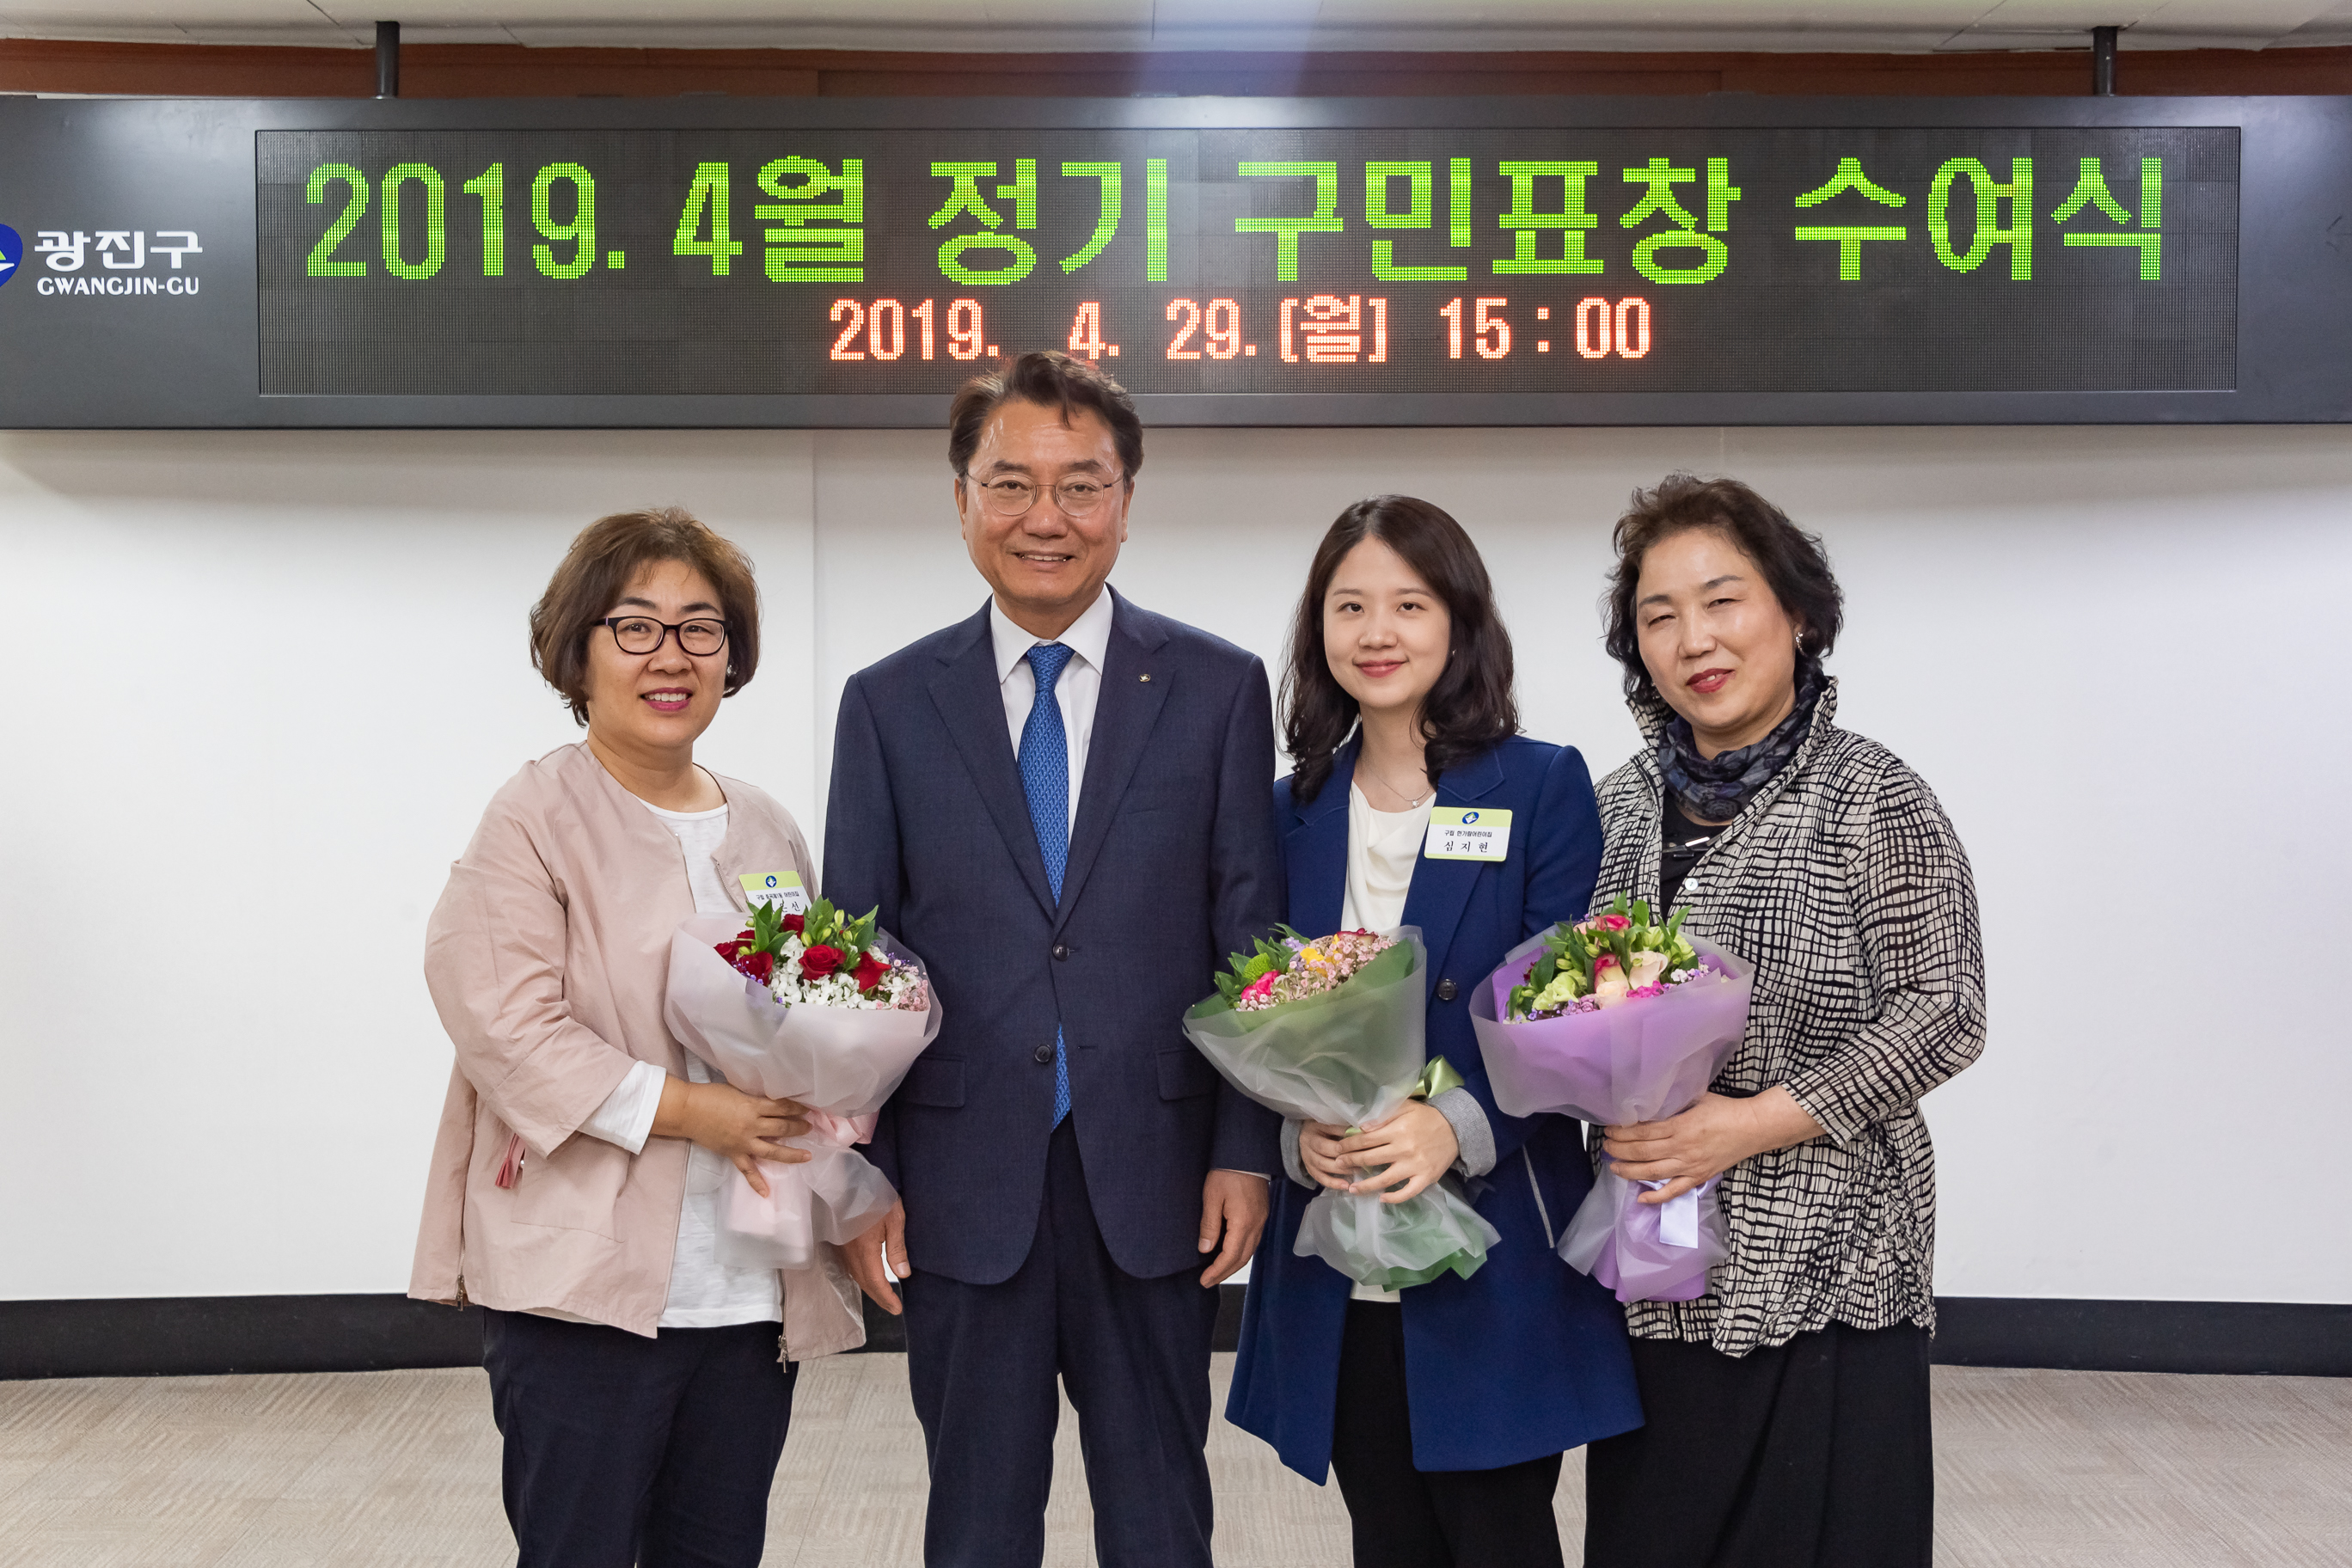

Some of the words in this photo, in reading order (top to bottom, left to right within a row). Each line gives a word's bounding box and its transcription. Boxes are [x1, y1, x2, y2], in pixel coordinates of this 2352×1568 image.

[306, 162, 625, 280] 2019.
[672, 155, 864, 283] 4월
[928, 158, 1168, 285] 정기
[1234, 157, 1742, 285] 구민표창
[1794, 156, 2162, 281] 수여식
[34, 230, 204, 273] 광진구
[37, 276, 199, 296] GWANGJIN-GU
[830, 297, 1001, 361] 2019.
[1068, 301, 1120, 361] 4.
